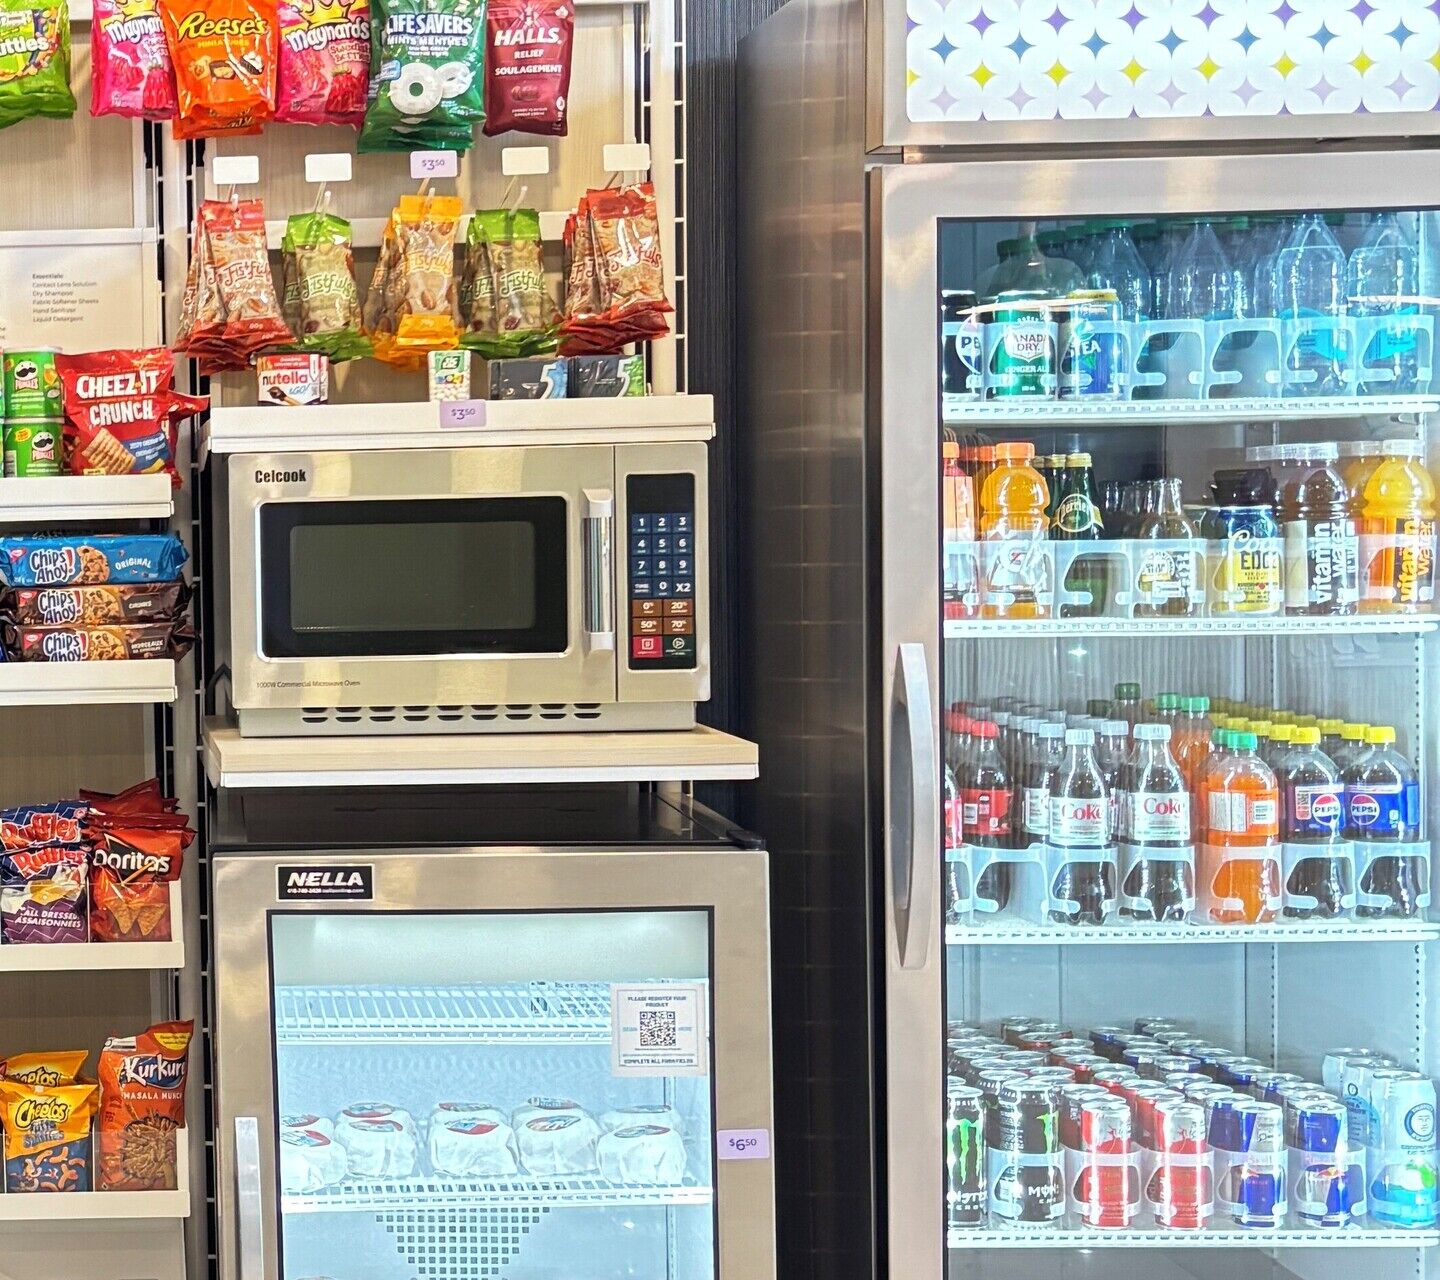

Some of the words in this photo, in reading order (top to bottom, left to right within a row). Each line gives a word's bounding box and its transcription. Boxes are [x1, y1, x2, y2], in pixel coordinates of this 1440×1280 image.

[176, 12, 268, 42] Reese's
[285, 20, 370, 52] Maynards
[514, 48, 544, 60] RELIEF
[495, 64, 563, 77] SOULAGEMENT
[76, 370, 160, 399] CHEEZ-IT
[262, 372, 308, 386] nutella
[539, 364, 558, 400] 5
[617, 358, 632, 397] 5
[89, 399, 154, 426] CRUNCH
[255, 469, 306, 483] Celcook
[639, 518, 644, 527] 1
[659, 518, 666, 527] 2
[679, 517, 686, 526] 3
[659, 539, 666, 548] 5
[679, 539, 686, 547] 6
[31, 550, 66, 570] Chips
[115, 558, 152, 570] ORIGINAL
[638, 561, 645, 570] 7
[659, 561, 666, 569] 8
[679, 560, 686, 569] 9
[1311, 521, 1332, 604] vitamin
[659, 582, 667, 590] 0
[676, 583, 691, 592] X2
[40, 591, 74, 609] Chips
[45, 634, 80, 652] Chips
[1, 812, 81, 850] Ruffles
[93, 849, 170, 872] Doritos
[287, 872, 364, 886] NELLA
[123, 1092, 159, 1101] MASALA
[16, 1099, 70, 1130] Cheetos
